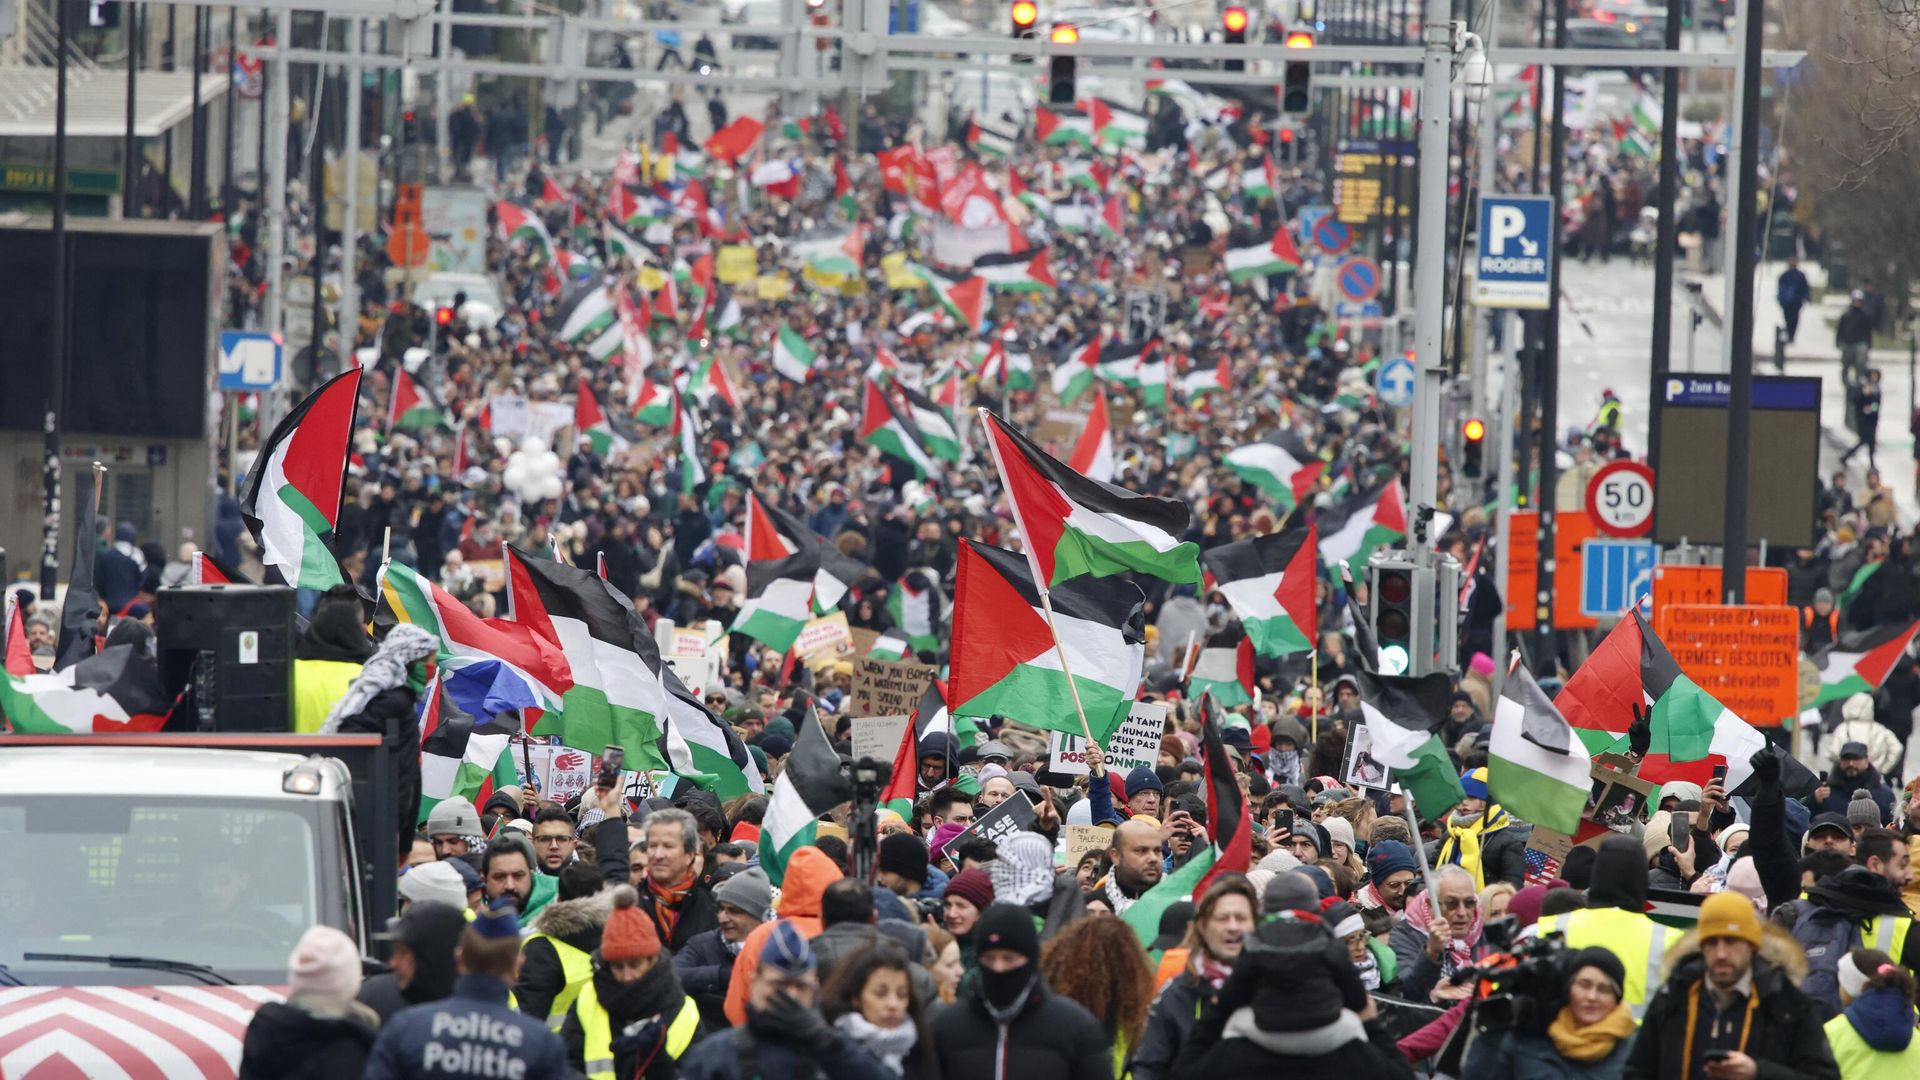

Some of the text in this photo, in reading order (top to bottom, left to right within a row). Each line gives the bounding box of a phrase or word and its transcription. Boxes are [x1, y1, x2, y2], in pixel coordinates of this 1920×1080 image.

[1489, 205, 1526, 255] P
[1481, 256, 1545, 274] ROGIER
[1689, 380, 1732, 394] Zone Ro
[1605, 483, 1645, 508] 50
[1614, 511, 1636, 521] km
[1729, 651, 1792, 667] GESLOTEN
[862, 660, 884, 675] WHEN
[888, 667, 903, 680] YOU
[863, 676, 919, 693] A WATERMELON
[1136, 717, 1162, 729] TANT
[1122, 727, 1162, 741] HUMAIN
[1111, 735, 1156, 750] PEUX PAS
[1106, 745, 1135, 757] AS ME
[977, 814, 1015, 840] ASE
[1072, 826, 1091, 834] FREE
[1078, 834, 1111, 845] PALESTIN
[431, 1011, 523, 1048] Police
[423, 1041, 527, 1080] Politie
